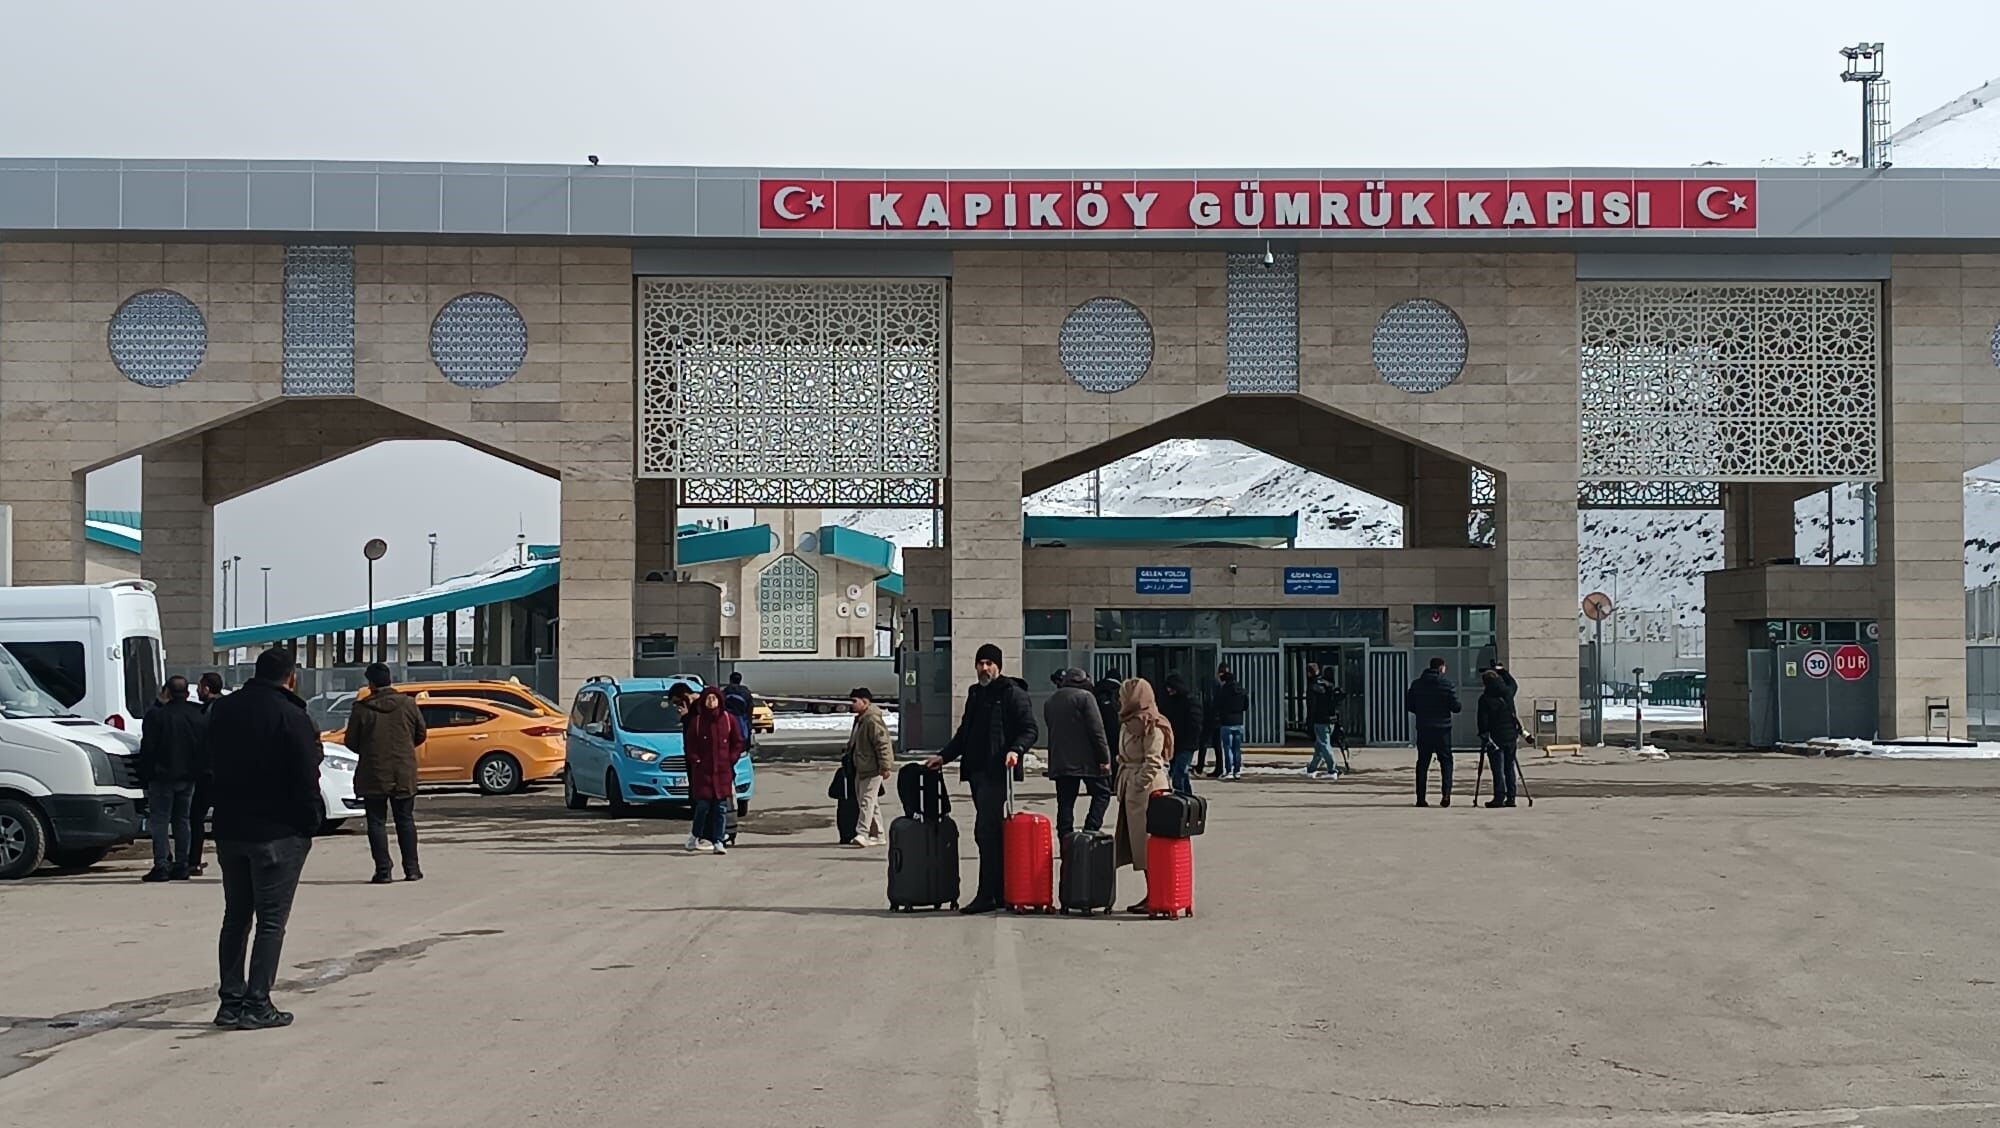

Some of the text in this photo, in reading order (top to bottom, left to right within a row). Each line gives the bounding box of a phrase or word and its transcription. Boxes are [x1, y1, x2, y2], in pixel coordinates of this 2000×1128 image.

[869, 180, 1651, 227] KAPIKÖY GÜMRÜK KAPISI
[1809, 659, 1826, 670] 30
[1836, 655, 1867, 670] DUR
